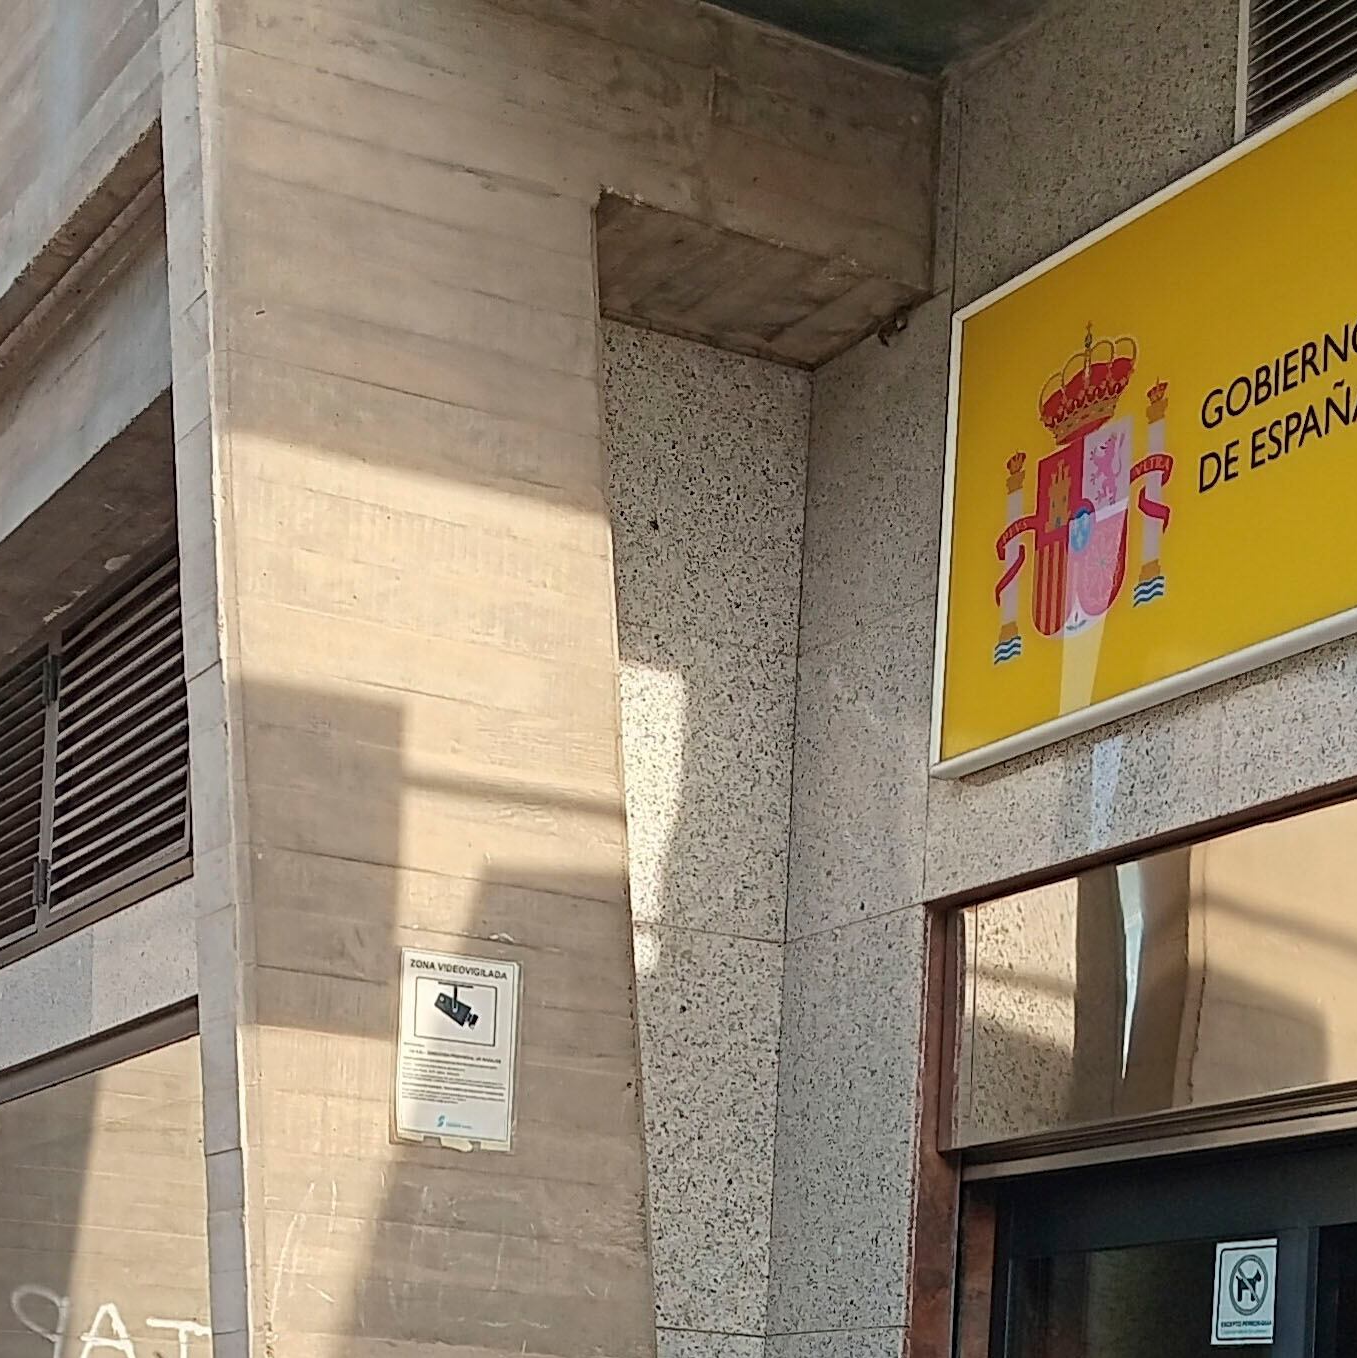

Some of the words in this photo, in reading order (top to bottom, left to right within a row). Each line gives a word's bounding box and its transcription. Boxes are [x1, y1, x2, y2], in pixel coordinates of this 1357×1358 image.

[1198, 440, 1240, 493] DE
[409, 958, 436, 970] ZONA
[437, 963, 508, 980] VIDEOVIGILADA
